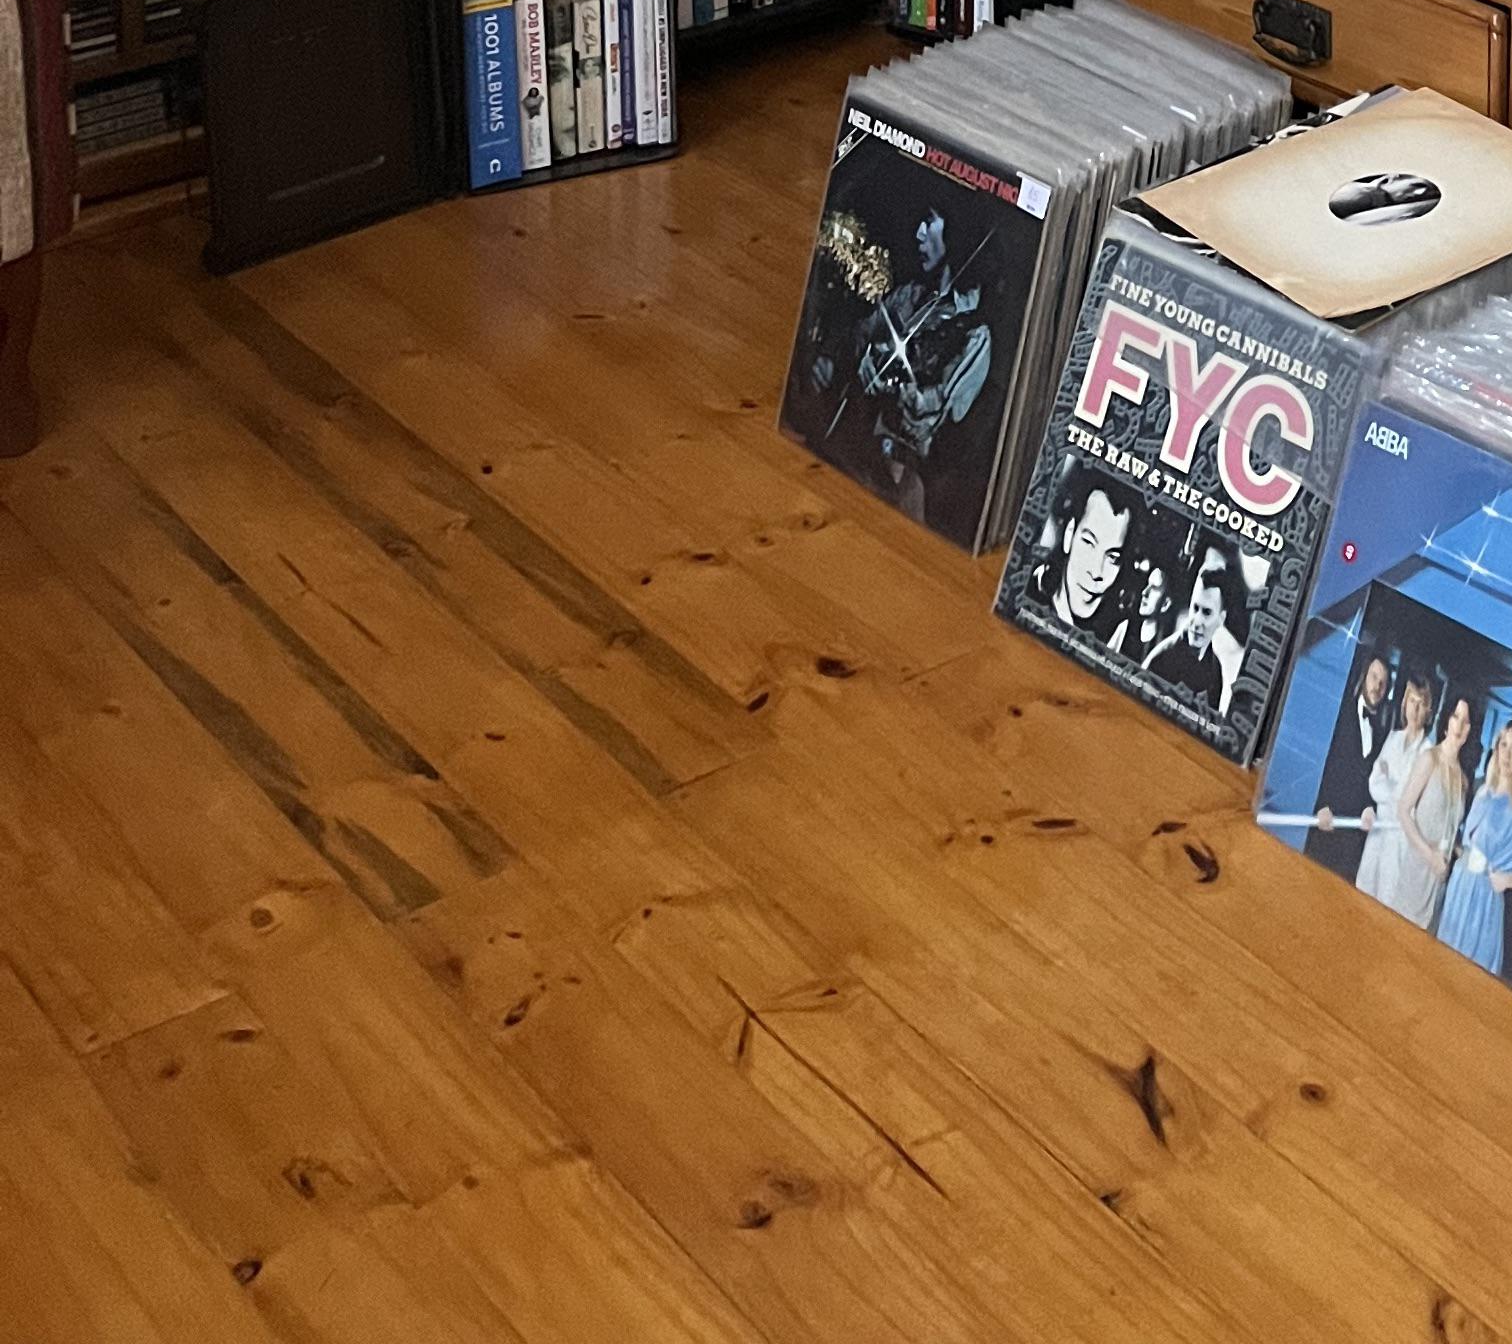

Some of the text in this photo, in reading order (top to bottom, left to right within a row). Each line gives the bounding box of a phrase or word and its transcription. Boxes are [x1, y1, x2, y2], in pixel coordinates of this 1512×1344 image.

[484, 14, 505, 132] 1001 ALBUMS
[528, 3, 542, 84] BOB MARLEY
[848, 108, 873, 133] NEIL
[873, 120, 926, 158] DIAMOND
[925, 145, 950, 170] HOT
[950, 157, 999, 194] AUGUST
[996, 181, 1020, 206] NIG
[1109, 274, 1328, 390] FINE YOUNG CANNIBALS
[1074, 299, 1315, 516] FYC
[1364, 421, 1408, 460] ABBA
[1067, 424, 1284, 552] THE RAW & THE COOKED
